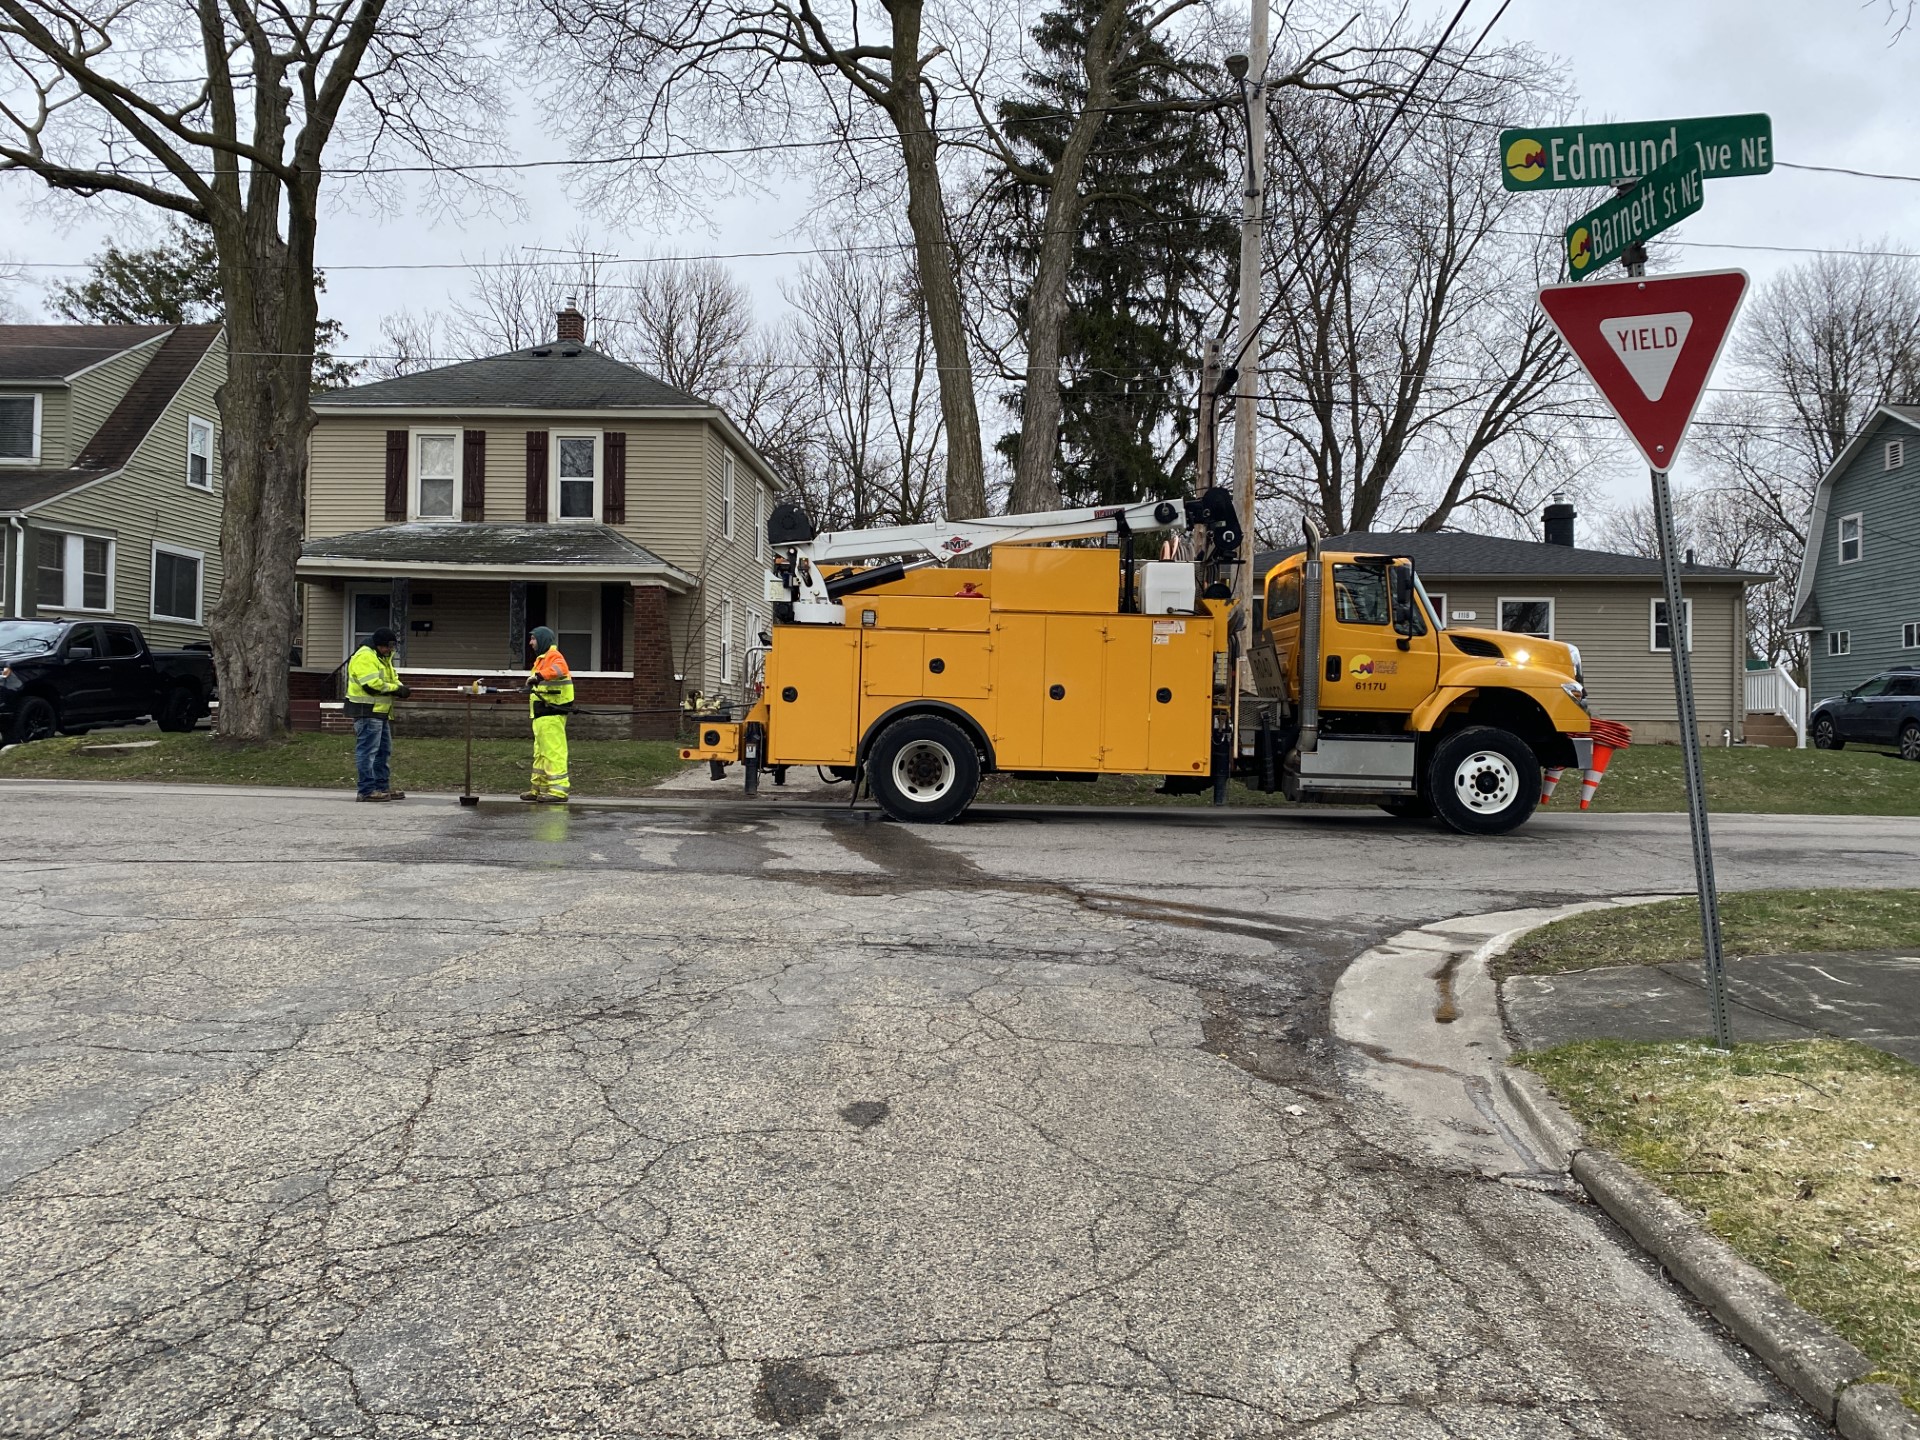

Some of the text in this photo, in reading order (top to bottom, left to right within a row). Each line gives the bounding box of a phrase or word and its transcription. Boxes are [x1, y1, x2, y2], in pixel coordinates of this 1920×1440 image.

[1551, 127, 1678, 181] Edmund
[1741, 136, 1769, 168] NE
[1591, 168, 1700, 261] Barnett St NE
[1617, 326, 1678, 351] YIELD
[1355, 682, 1387, 691] 6117U
